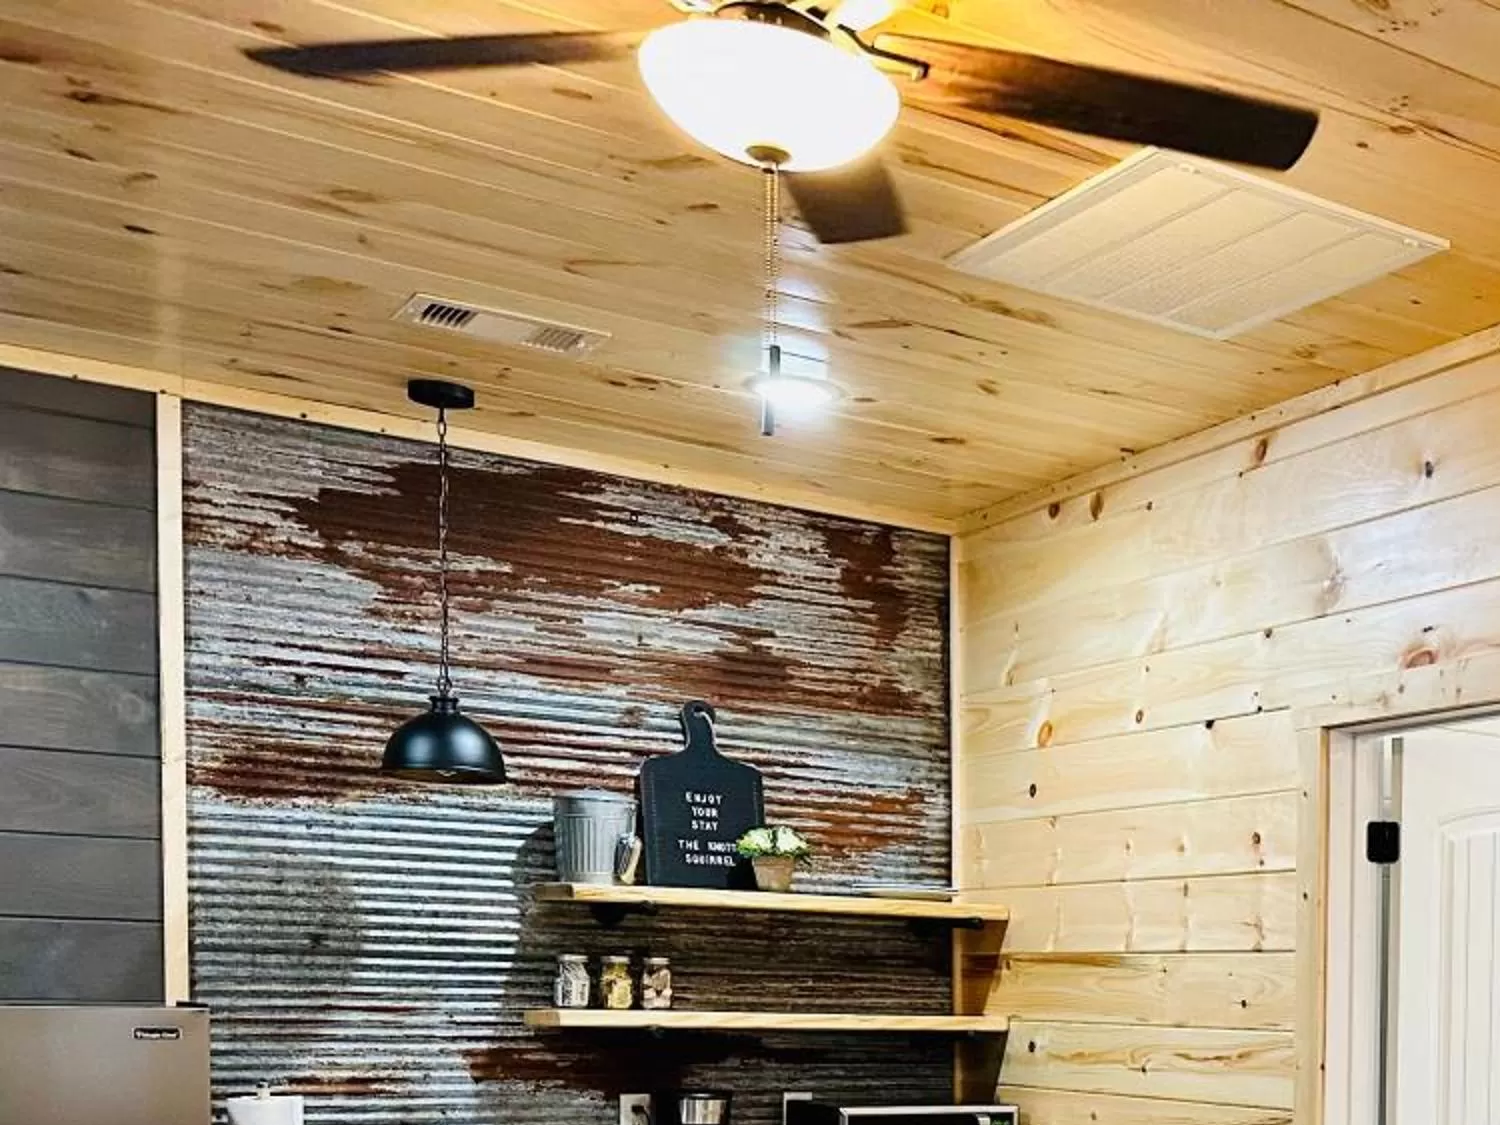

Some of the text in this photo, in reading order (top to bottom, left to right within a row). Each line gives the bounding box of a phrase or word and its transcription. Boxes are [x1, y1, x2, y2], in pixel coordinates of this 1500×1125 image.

[685, 791, 722, 805] ENJOY
[691, 805, 719, 818] YOUR
[691, 819, 719, 831] STAY
[677, 839, 738, 852] THE KNOTT
